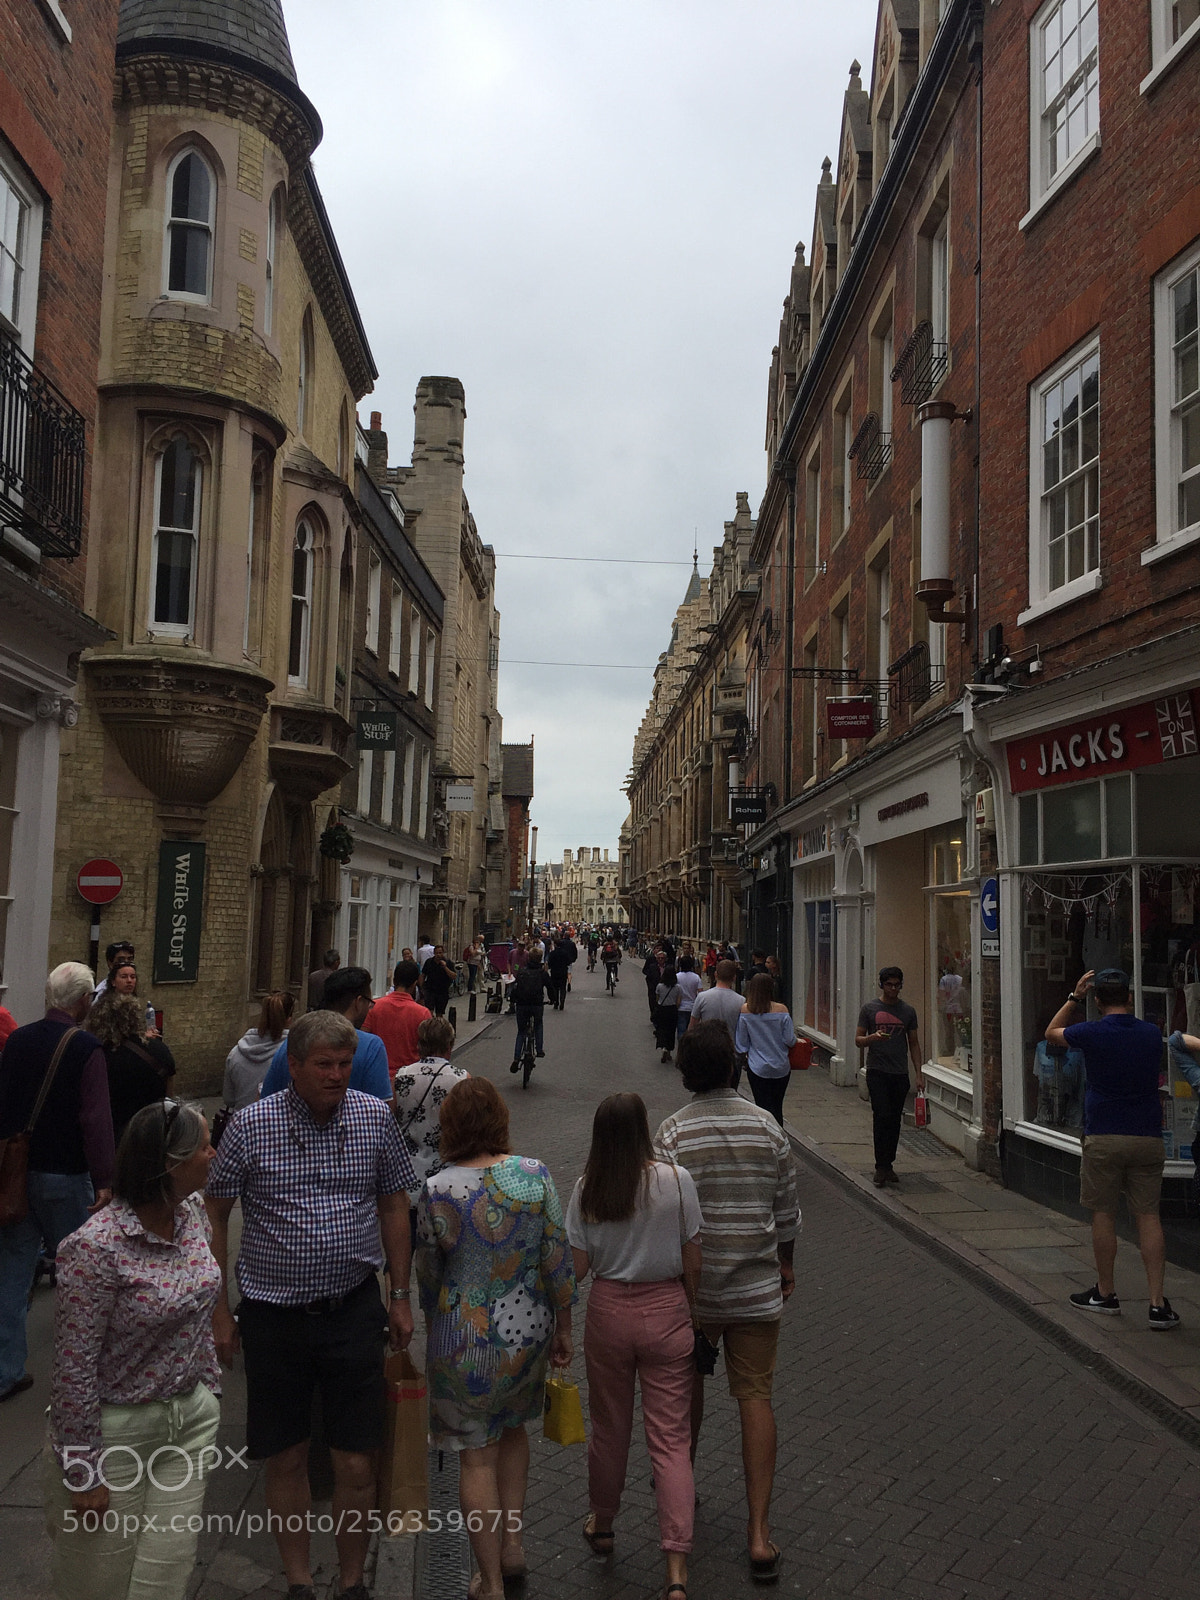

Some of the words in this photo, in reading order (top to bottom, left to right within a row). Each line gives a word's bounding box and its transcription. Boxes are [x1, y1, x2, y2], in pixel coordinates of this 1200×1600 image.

[1037, 723, 1124, 776] JACKS
[1167, 718, 1185, 734] ON
[983, 943, 992, 951] One
